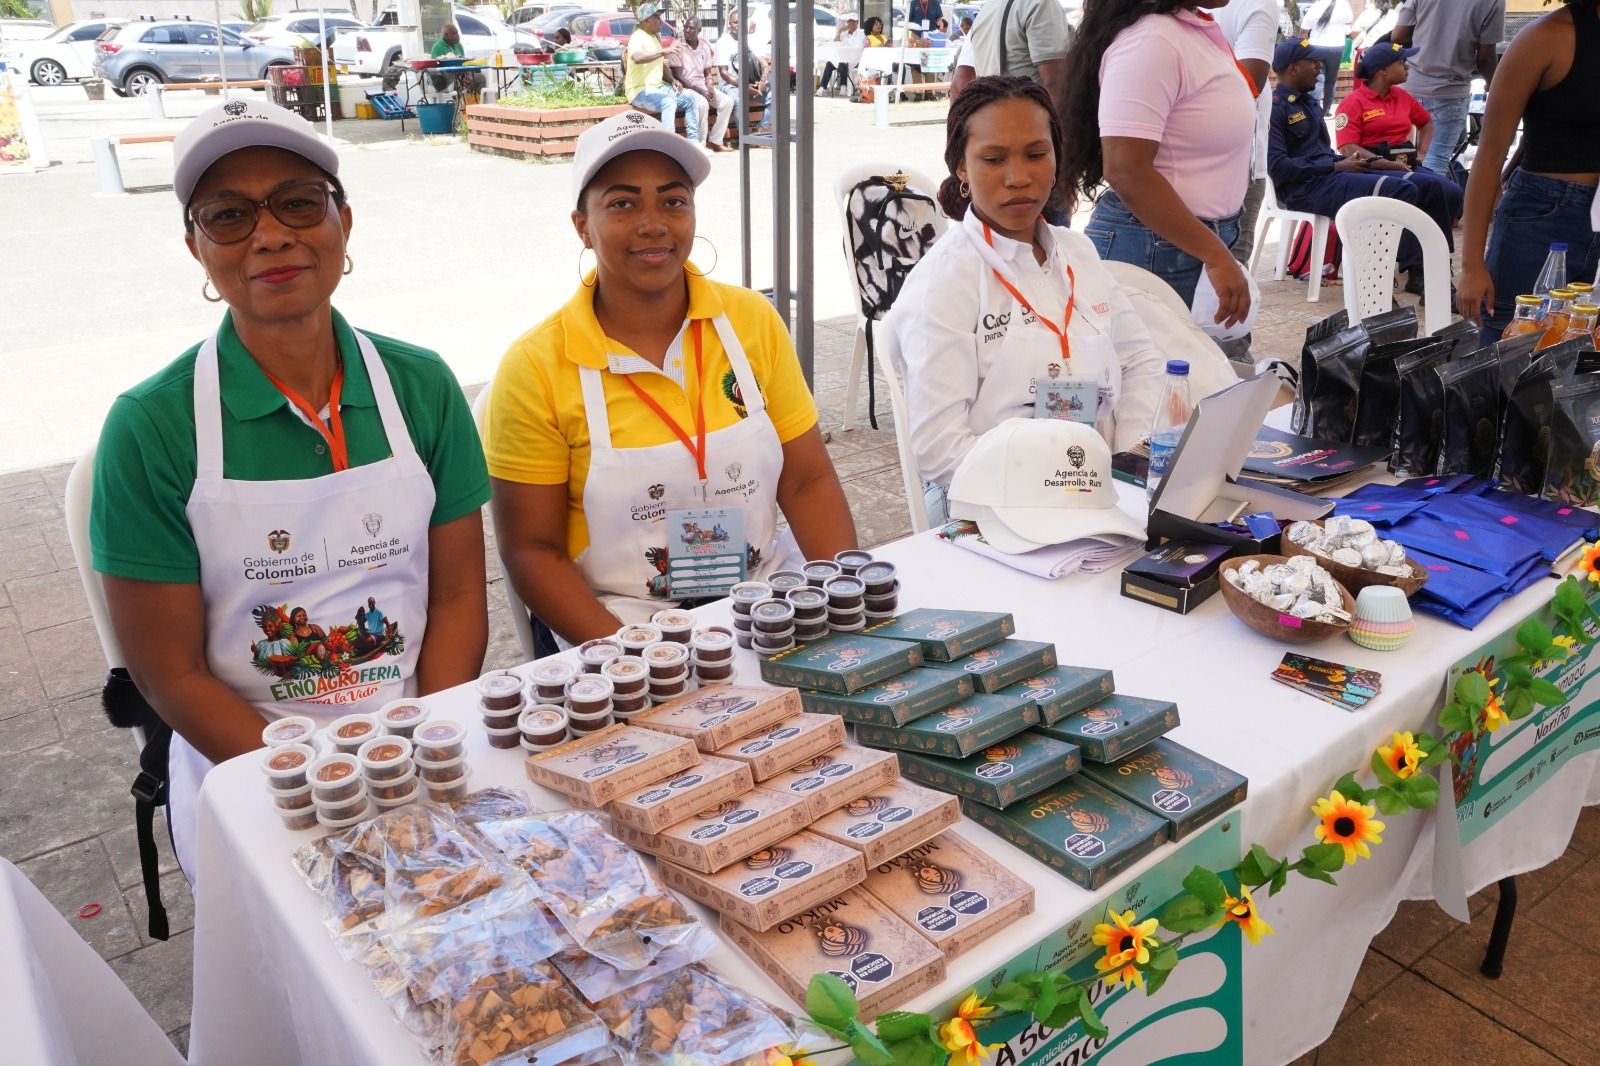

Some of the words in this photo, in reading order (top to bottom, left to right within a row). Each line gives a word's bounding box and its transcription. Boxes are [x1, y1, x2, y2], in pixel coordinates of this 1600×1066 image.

[1055, 469, 1088, 479] Agencia
[1089, 469, 1098, 478] de
[714, 484, 747, 496] Agencia
[1044, 478, 1086, 488] Desarrollo
[350, 540, 388, 555] Agencia
[389, 537, 400, 546] de
[243, 554, 299, 568] Gobierno
[301, 552, 315, 561] de
[338, 551, 388, 568] Desarrollo
[389, 544, 409, 558] Rural
[244, 562, 316, 581] Colombia
[269, 664, 401, 701] ETNOAGROFERIA
[334, 693, 347, 704] la
[1053, 938, 1080, 959] Agencia
[1080, 932, 1089, 943] de
